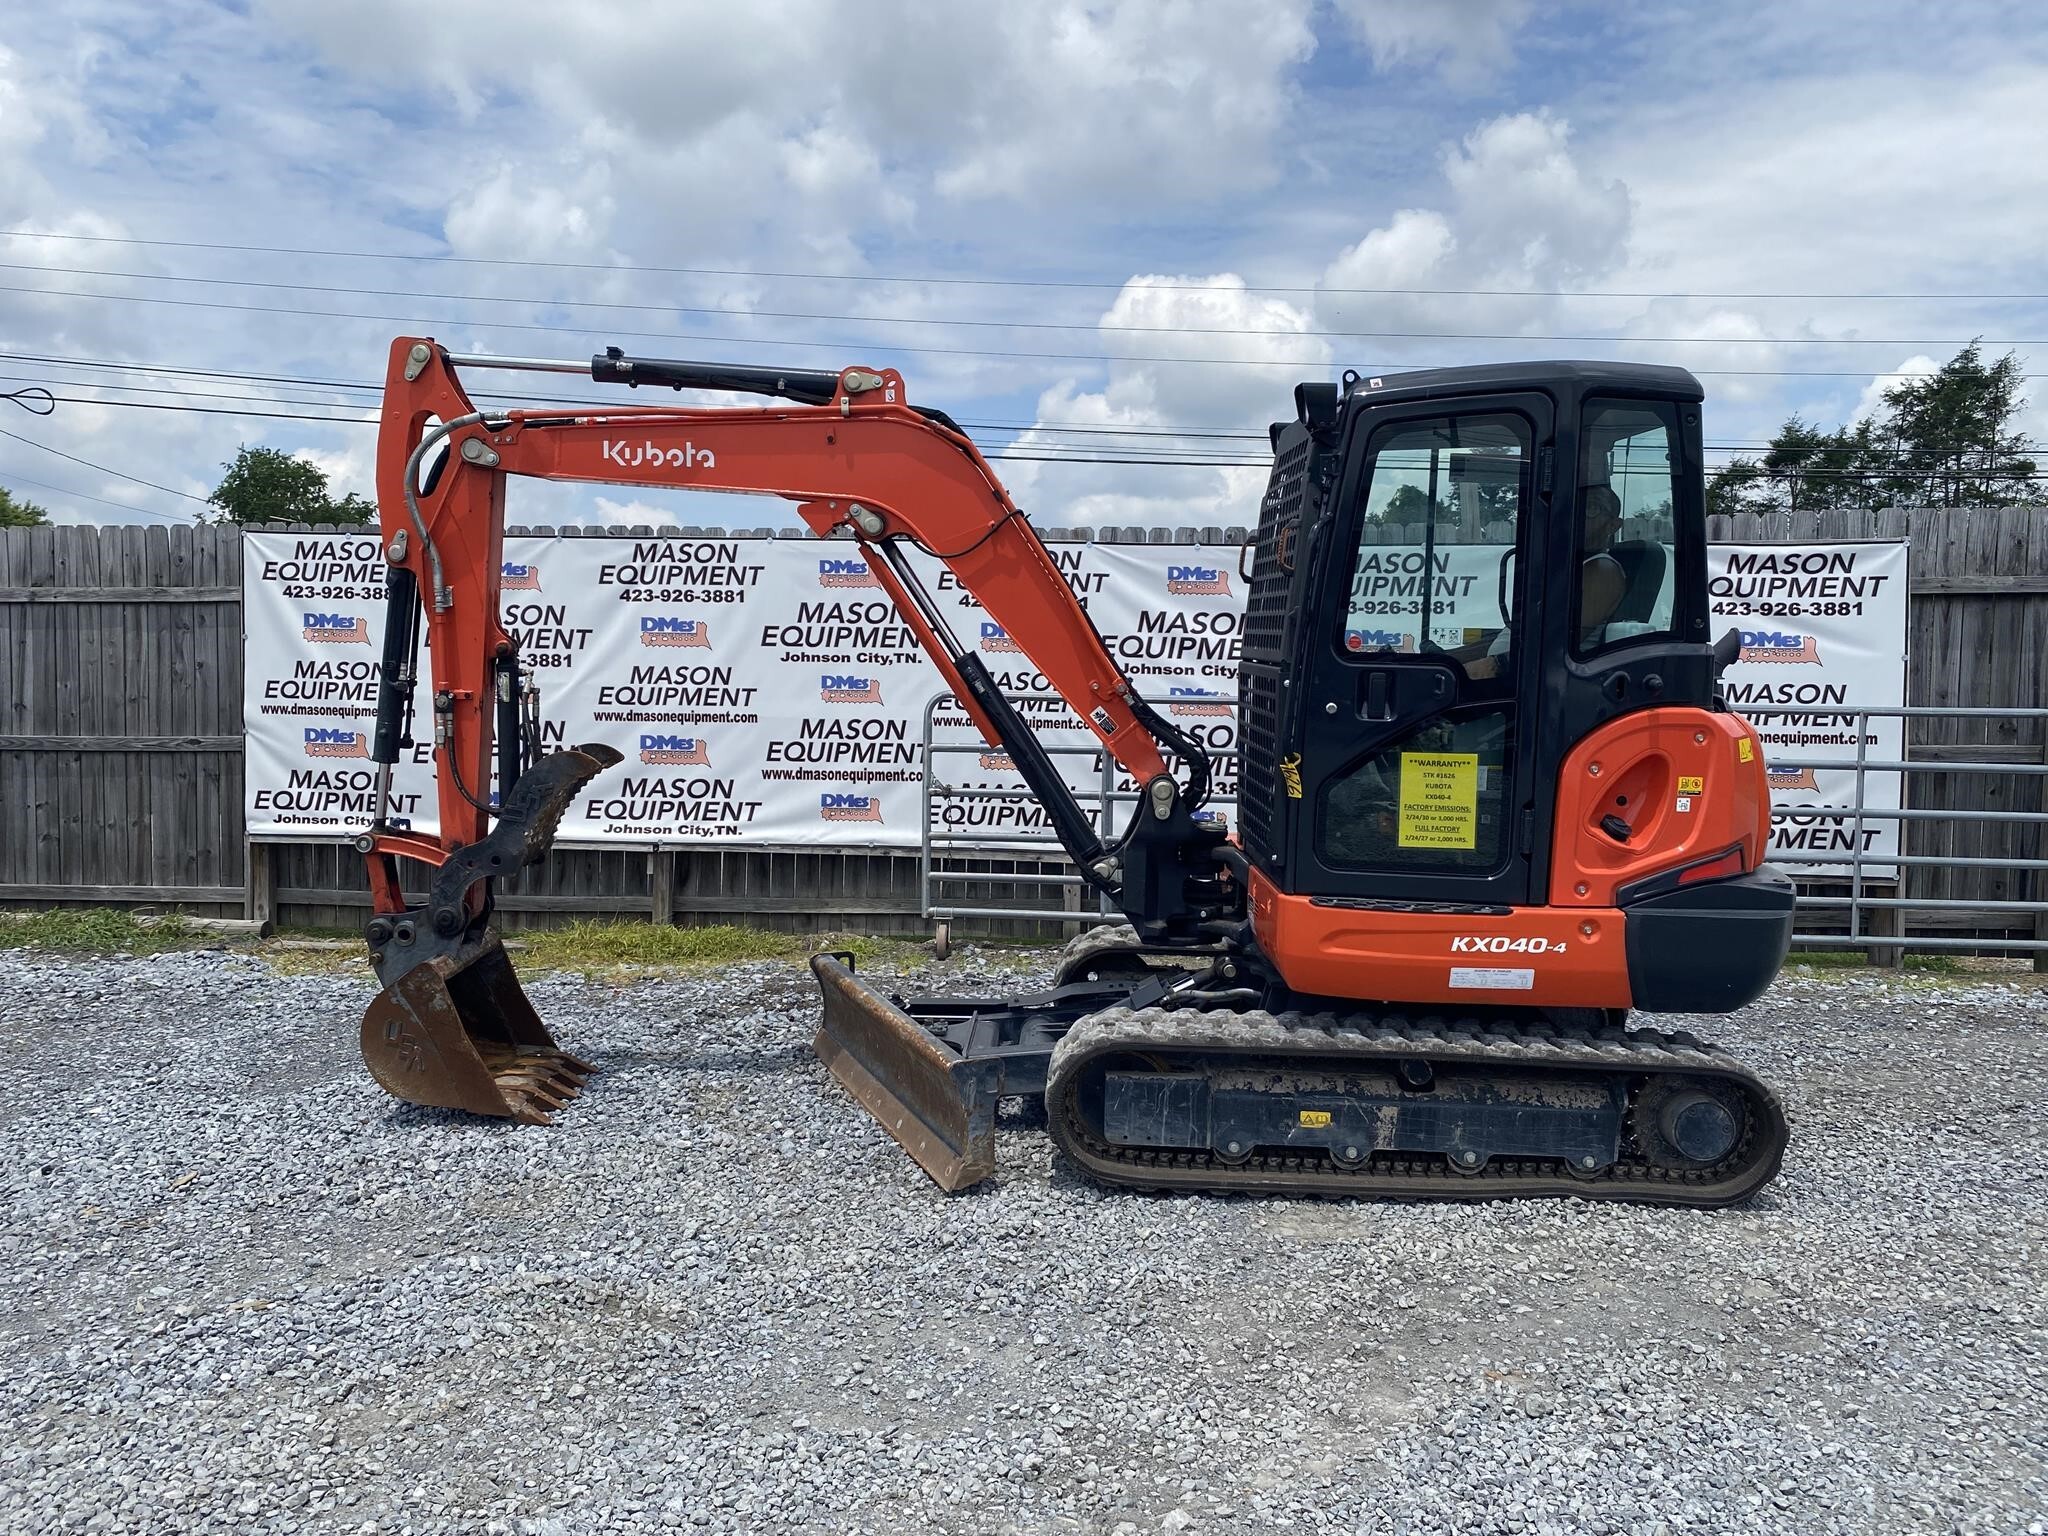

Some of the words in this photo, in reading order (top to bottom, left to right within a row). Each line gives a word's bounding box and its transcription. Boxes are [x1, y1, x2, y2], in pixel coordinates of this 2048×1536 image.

[603, 440, 715, 468] Kubota
[632, 543, 738, 564] MASON
[1726, 553, 1856, 574] MASON
[262, 561, 388, 583] EQUIPME
[598, 565, 765, 586] EQUIPMENT
[283, 586, 390, 599] 423-926-388
[619, 589, 745, 603] 423-926-3881
[1709, 576, 1888, 598] QUIPMENT
[503, 604, 566, 626] SON
[1712, 602, 1863, 616] 423-926-3881
[761, 626, 919, 649] EQUIPMEN
[1102, 635, 1243, 660] EQUIPME
[780, 652, 850, 663] Johnson
[630, 666, 732, 685] MASON
[1123, 663, 1194, 676] Johnson
[264, 680, 379, 701] EQUIPME
[598, 686, 757, 707] EQUIPMENT
[1726, 684, 1847, 704] MASON
[594, 709, 758, 726] www.dmasonequipment.com
[800, 719, 907, 740] MASON
[762, 767, 922, 785] www.dmasonequipment.co
[621, 778, 734, 799] MASON
[254, 790, 422, 814] EQUIPMENT
[585, 800, 762, 822] EQUIPMENT
[1404, 803, 1432, 811] FACTORY
[273, 814, 338, 826] Johnson
[603, 824, 672, 835] Johnson
[1415, 824, 1429, 832] FULL
[1431, 825, 1460, 833] FACTORY
[1450, 937, 1567, 953] KX040-4
